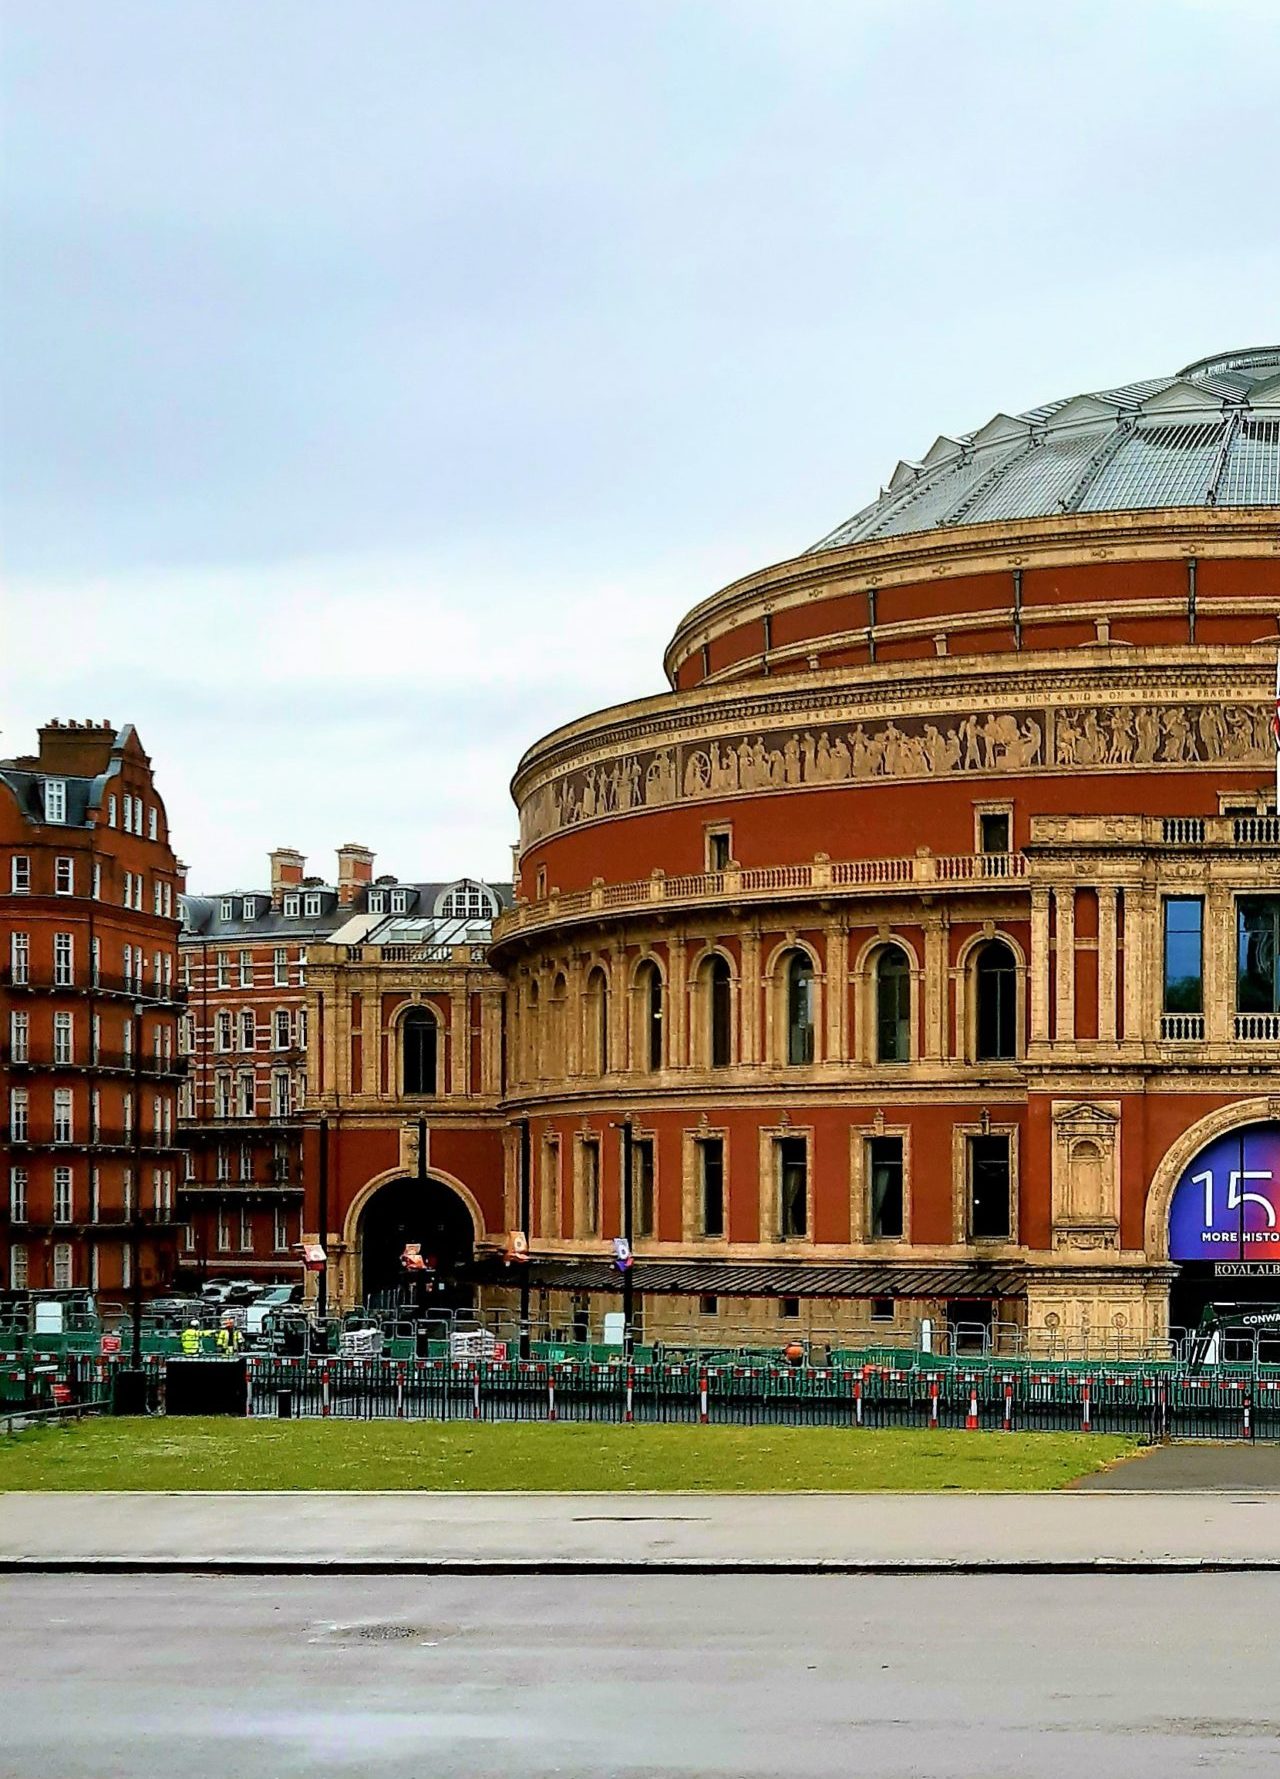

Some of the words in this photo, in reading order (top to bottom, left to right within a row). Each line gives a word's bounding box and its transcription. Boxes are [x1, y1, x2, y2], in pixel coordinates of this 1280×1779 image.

[994, 696, 1008, 705] ON
[1109, 691, 1123, 700] ON
[1142, 690, 1178, 699] EARTH
[1196, 689, 1232, 698] PEACE
[1202, 1232, 1238, 1242] MORE
[1215, 1264, 1255, 1275] ROYAL
